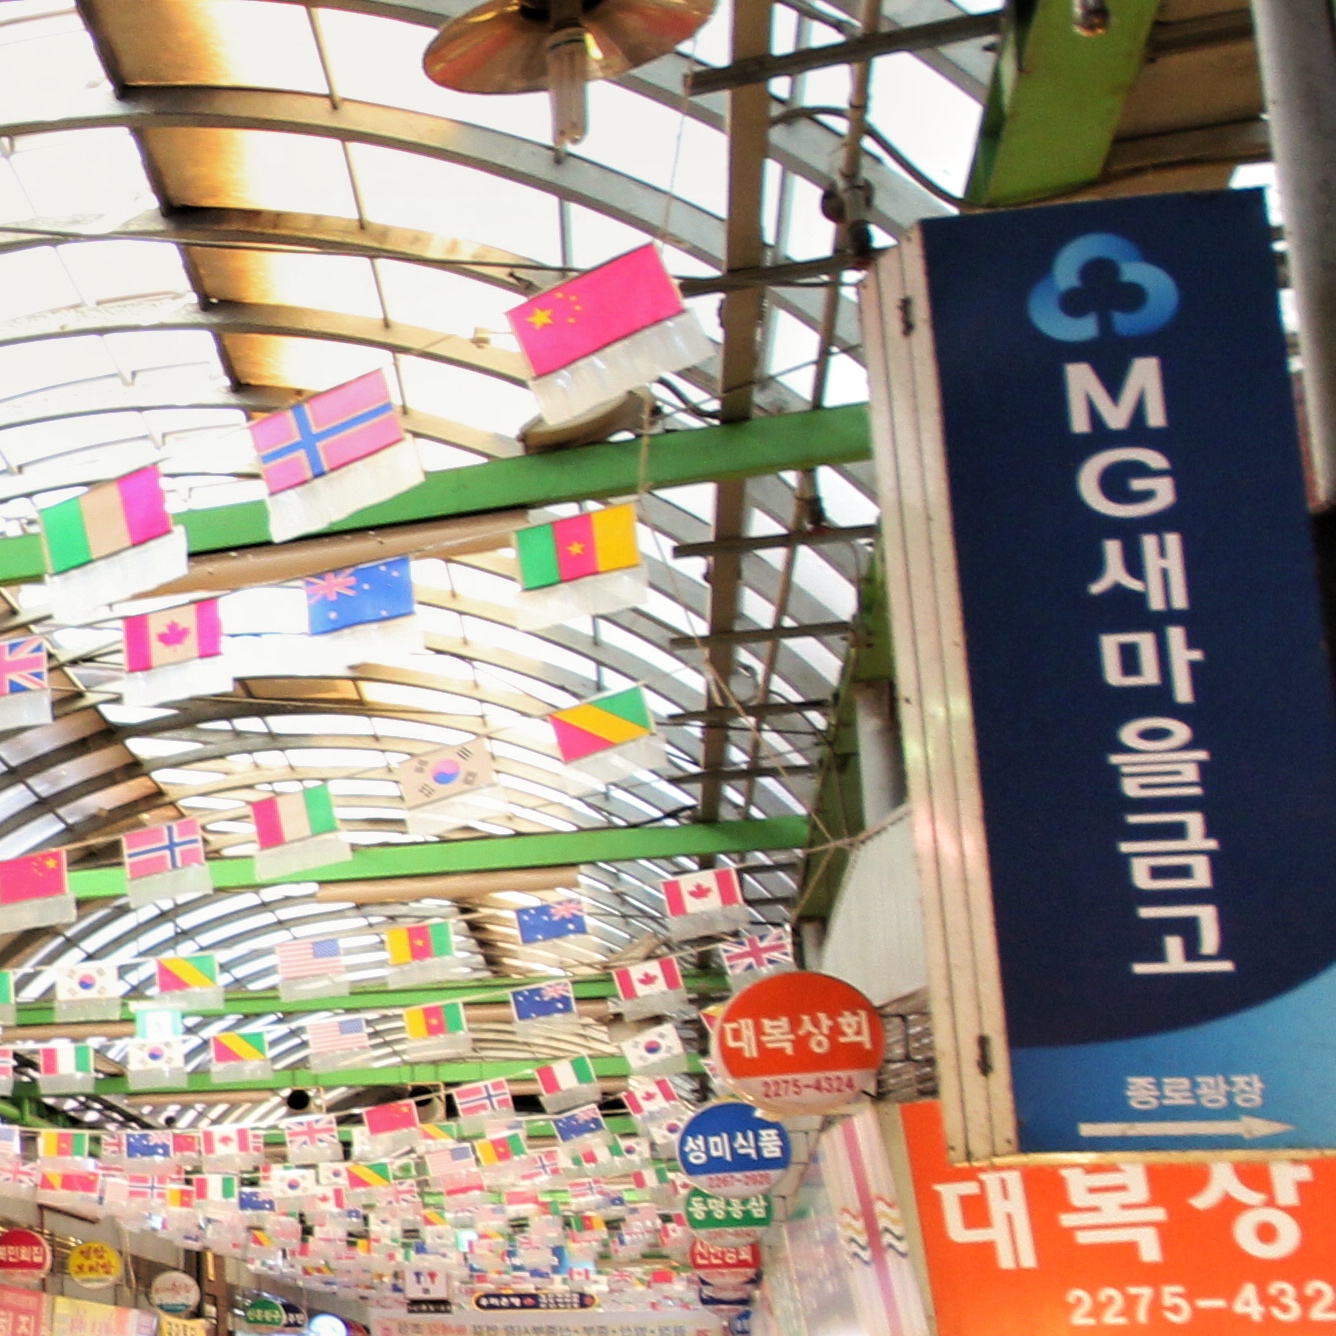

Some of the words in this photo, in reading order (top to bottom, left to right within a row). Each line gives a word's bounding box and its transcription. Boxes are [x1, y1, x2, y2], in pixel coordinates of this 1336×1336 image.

[1062, 356, 1236, 976] MG새마을금고
[723, 1009, 872, 1058] 대복상회
[1125, 1074, 1265, 1110] 종로광장
[684, 1128, 782, 1166] 성미식품
[932, 1161, 1314, 1270] 대복상
